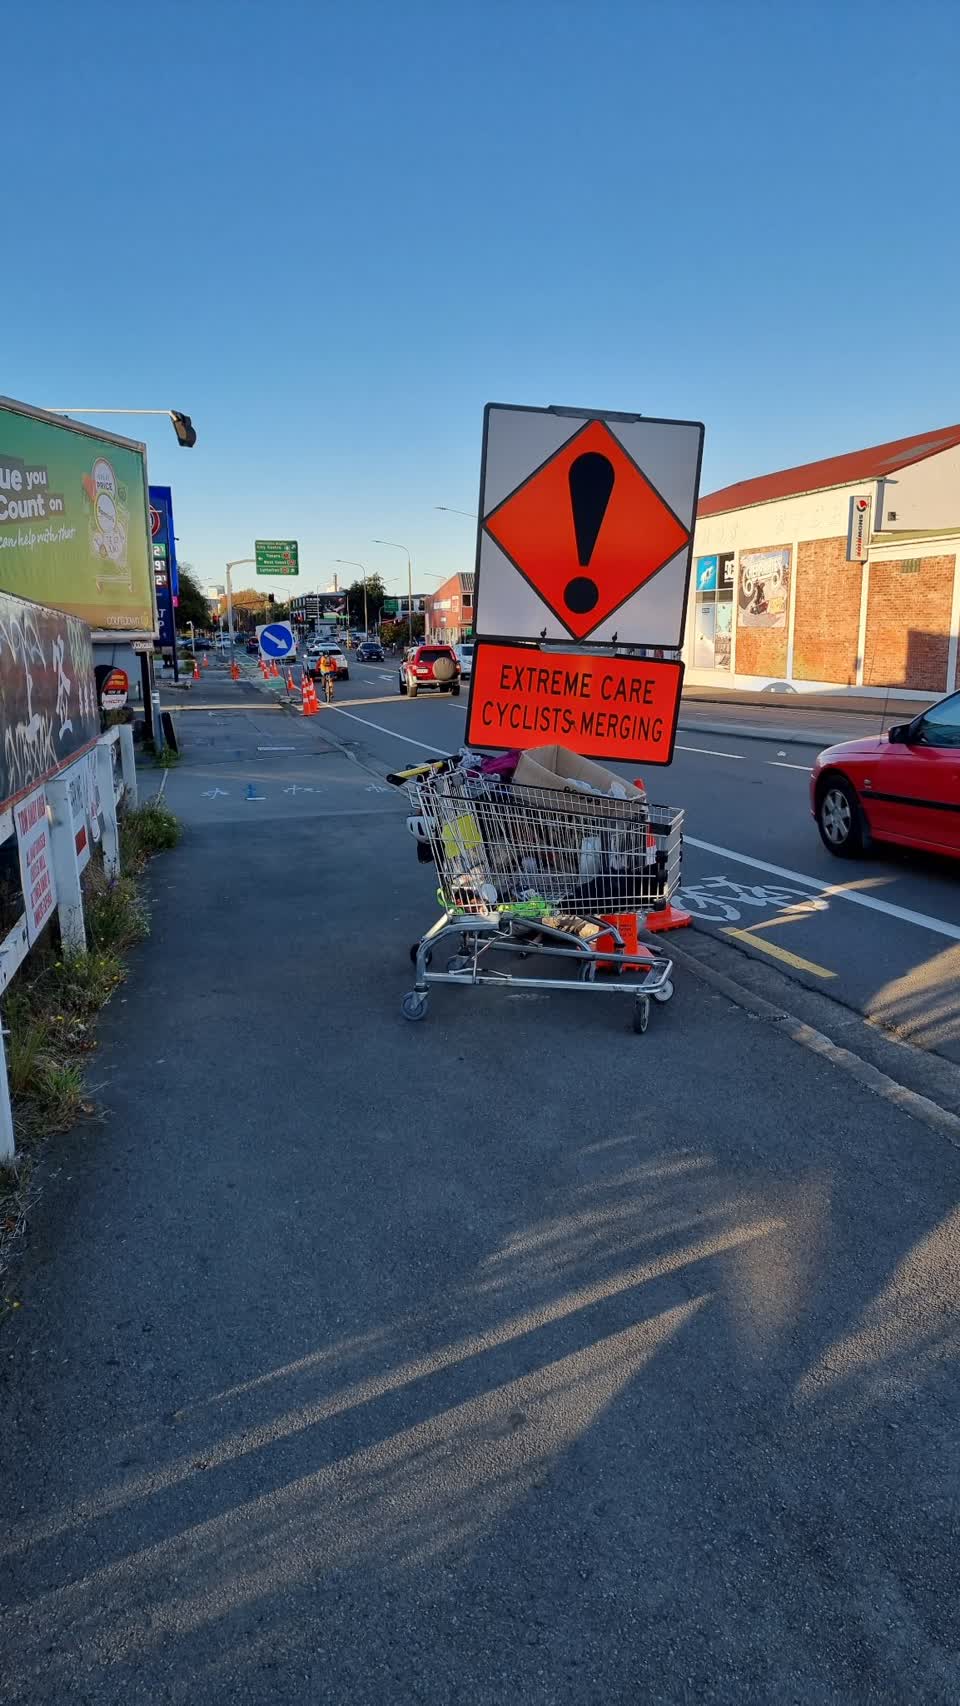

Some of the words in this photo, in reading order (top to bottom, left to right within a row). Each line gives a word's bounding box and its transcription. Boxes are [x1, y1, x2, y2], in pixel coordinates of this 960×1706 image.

[26, 471, 47, 490] you
[49, 498, 63, 511] on
[500, 664, 593, 698] EXTREME
[601, 675, 656, 704] CARE
[482, 701, 573, 734] CYCLISTS
[581, 712, 663, 742] MERGING
